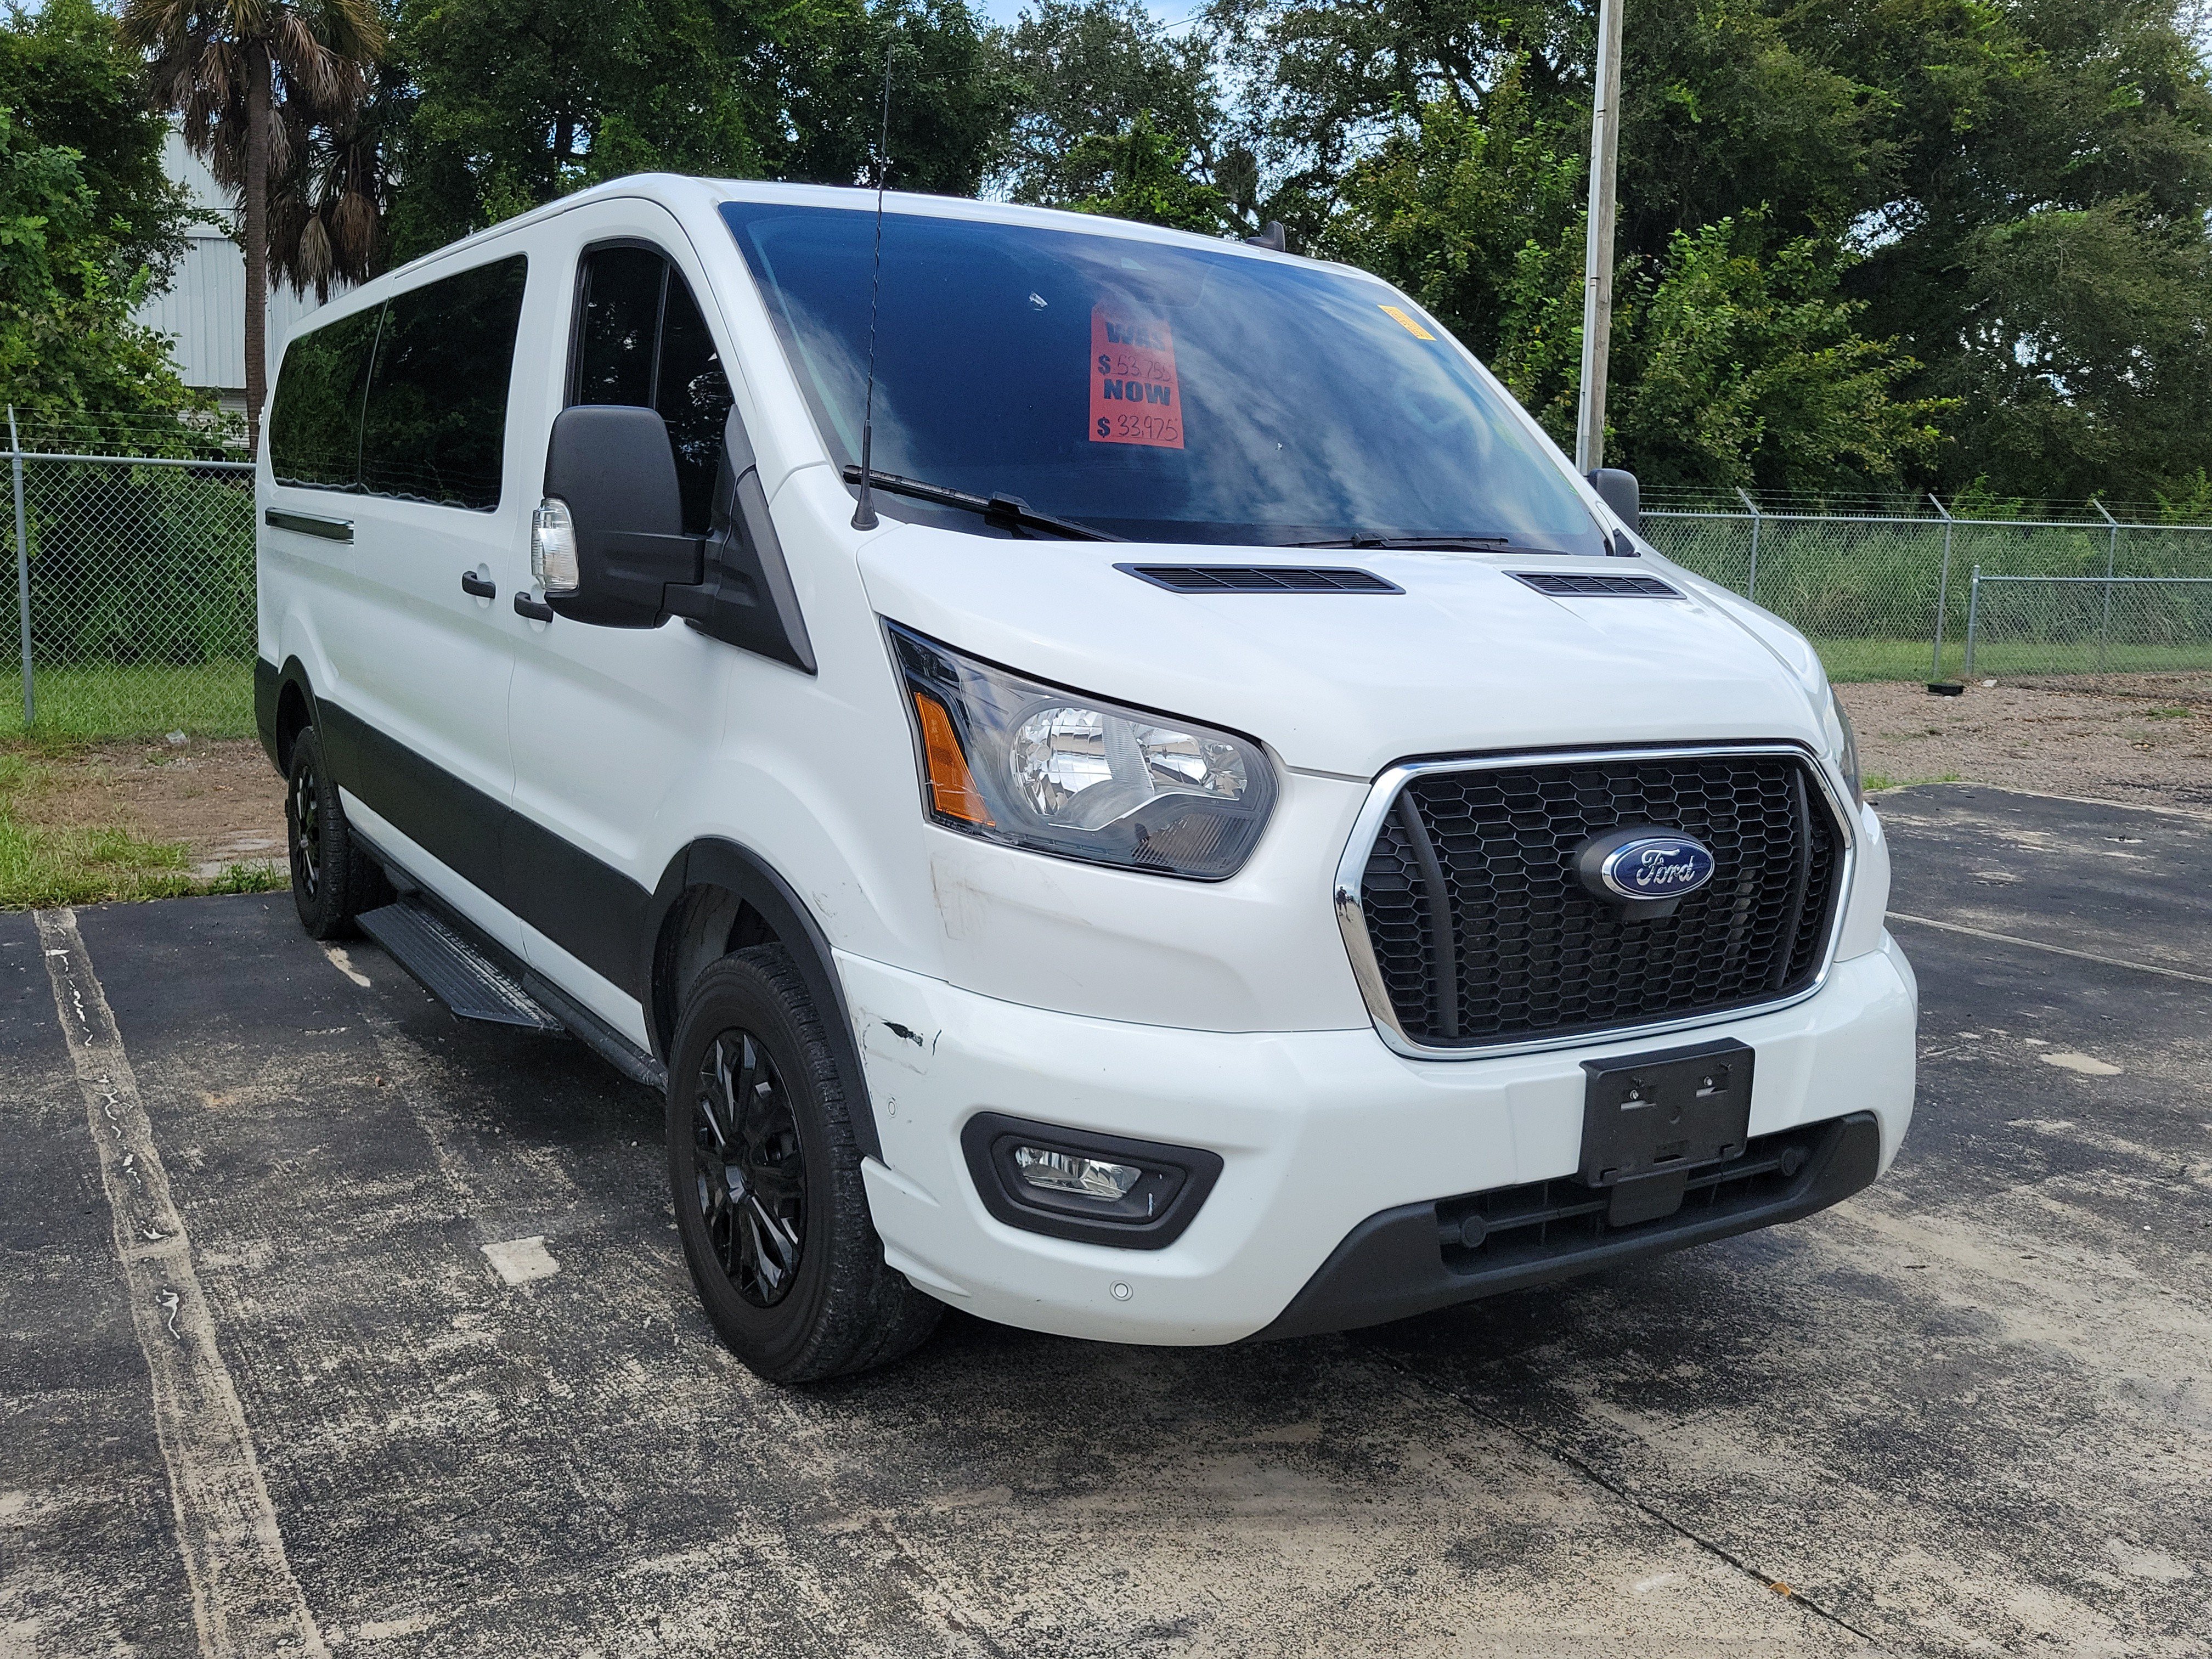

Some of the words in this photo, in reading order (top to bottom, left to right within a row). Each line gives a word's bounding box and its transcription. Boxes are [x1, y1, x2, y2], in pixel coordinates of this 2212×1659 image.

[1098, 354, 1111, 375] $
[1104, 379, 1171, 406] NOW
[1097, 416, 1111, 438] $
[1637, 849, 1695, 885] Ford
